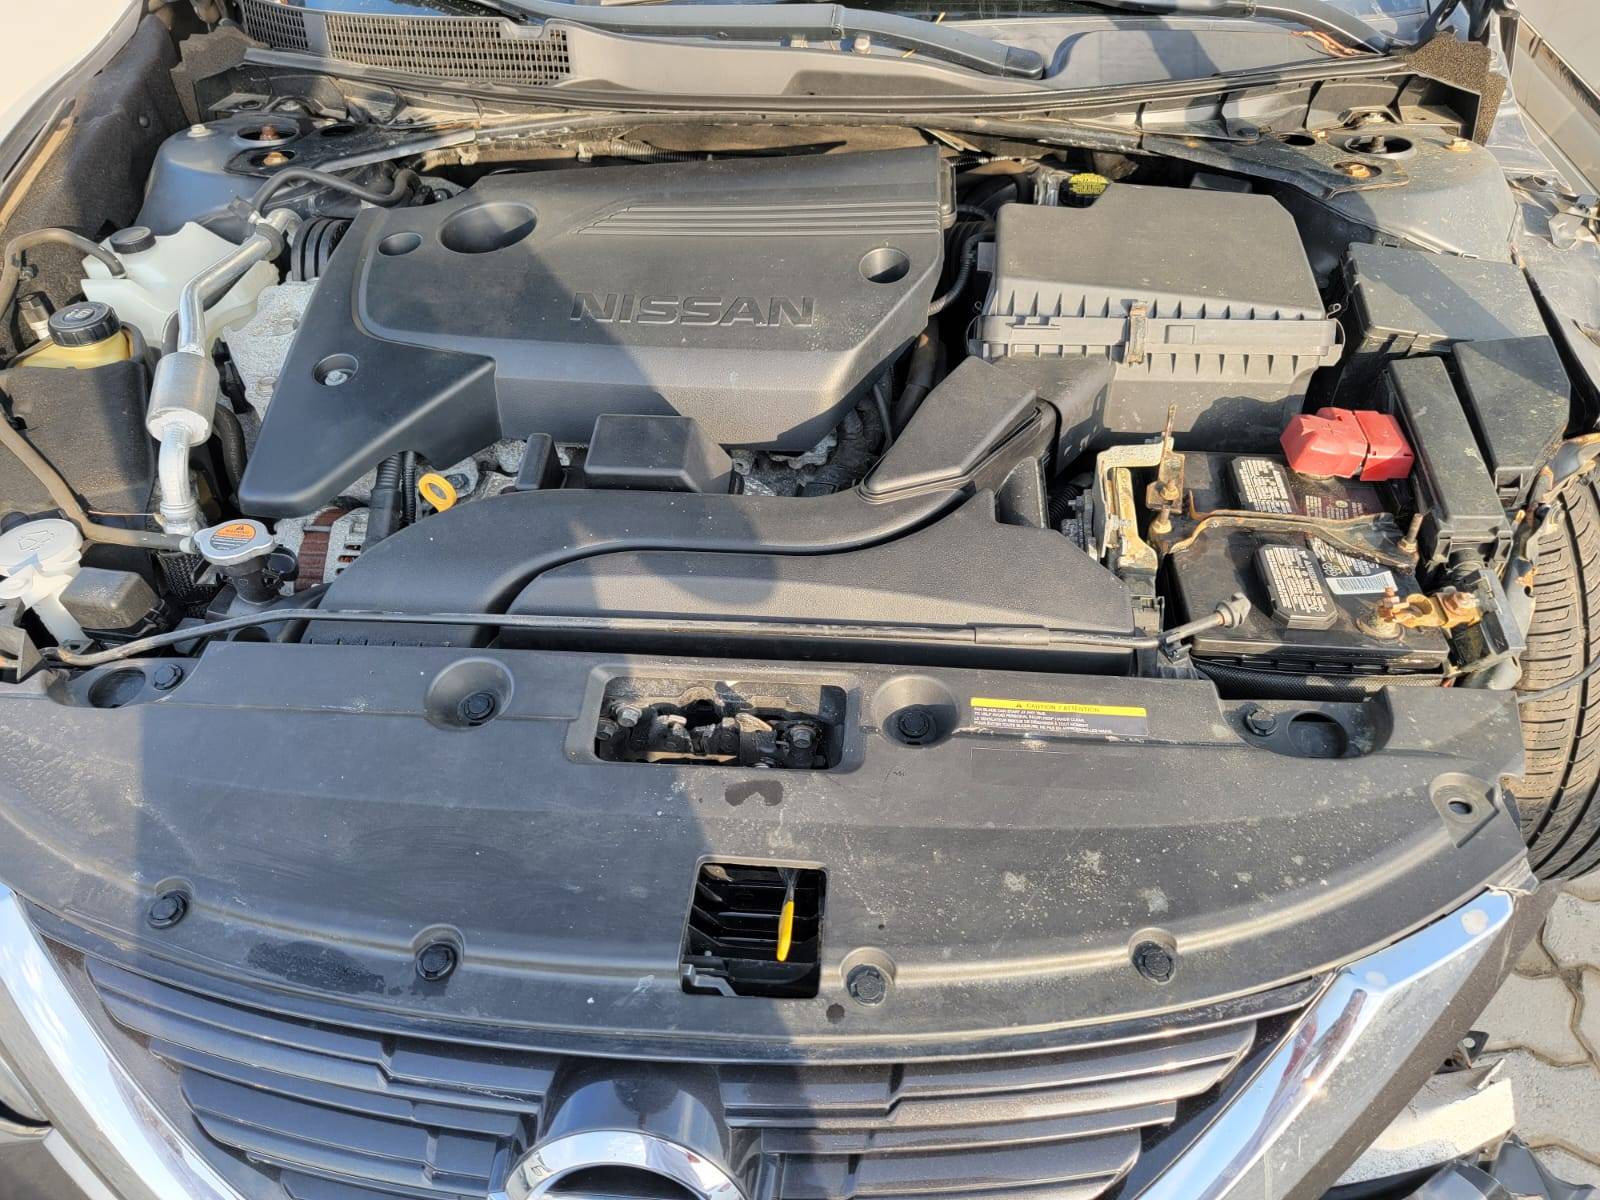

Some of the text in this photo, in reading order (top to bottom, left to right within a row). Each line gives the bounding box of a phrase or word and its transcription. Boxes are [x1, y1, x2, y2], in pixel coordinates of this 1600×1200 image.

[570, 292, 815, 327] NISSAN
[1026, 703, 1056, 711] CAUTION
[1063, 705, 1100, 713] ATTENTION
